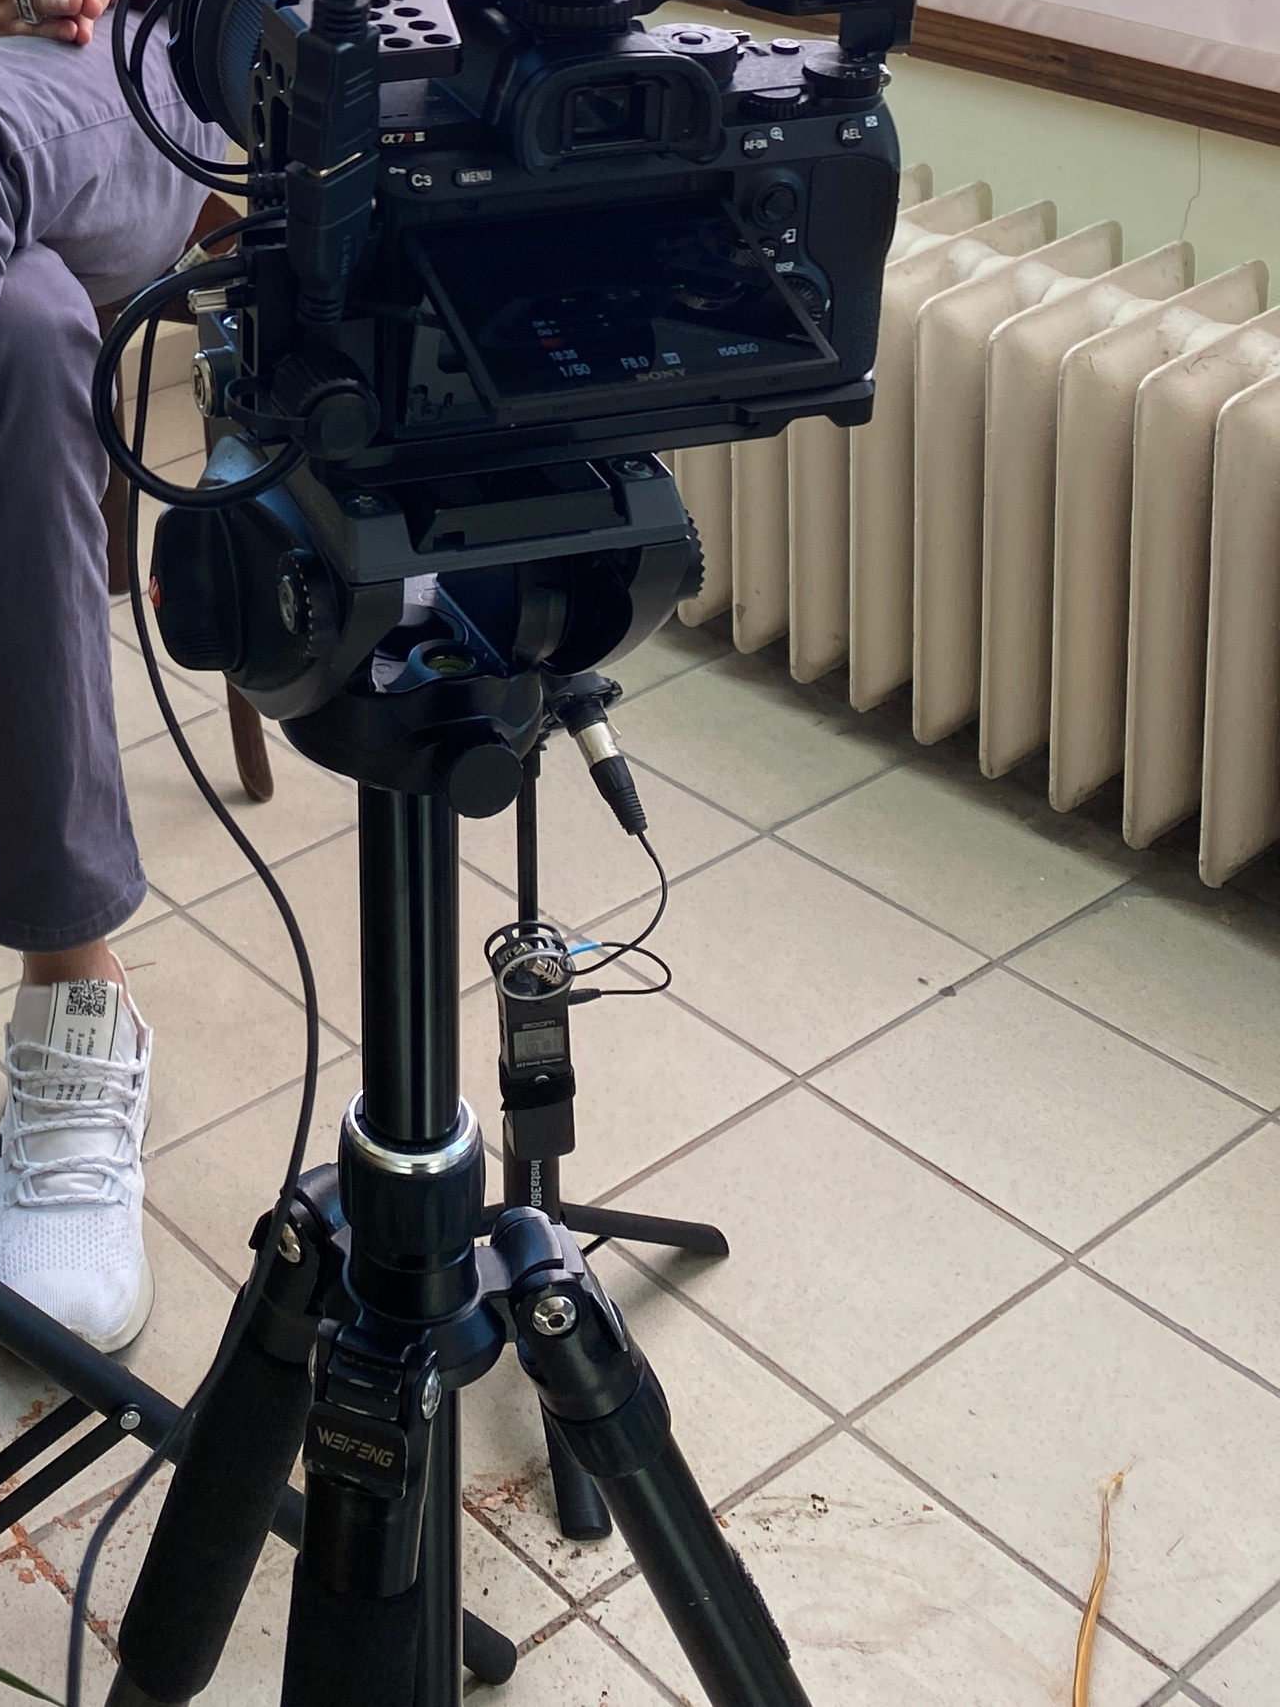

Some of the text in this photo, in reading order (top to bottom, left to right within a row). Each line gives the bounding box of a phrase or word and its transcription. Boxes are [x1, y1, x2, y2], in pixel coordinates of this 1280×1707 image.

[842, 128, 862, 140] AEL
[744, 139, 768, 150] AF-ON
[411, 174, 432, 186] C3
[461, 170, 492, 183] MENU
[559, 363, 591, 377] 1/50
[621, 356, 649, 370] F8.0
[636, 368, 686, 382] SONY
[531, 1159, 542, 1207] Insta360
[317, 1426, 395, 1468] WEIFENG
